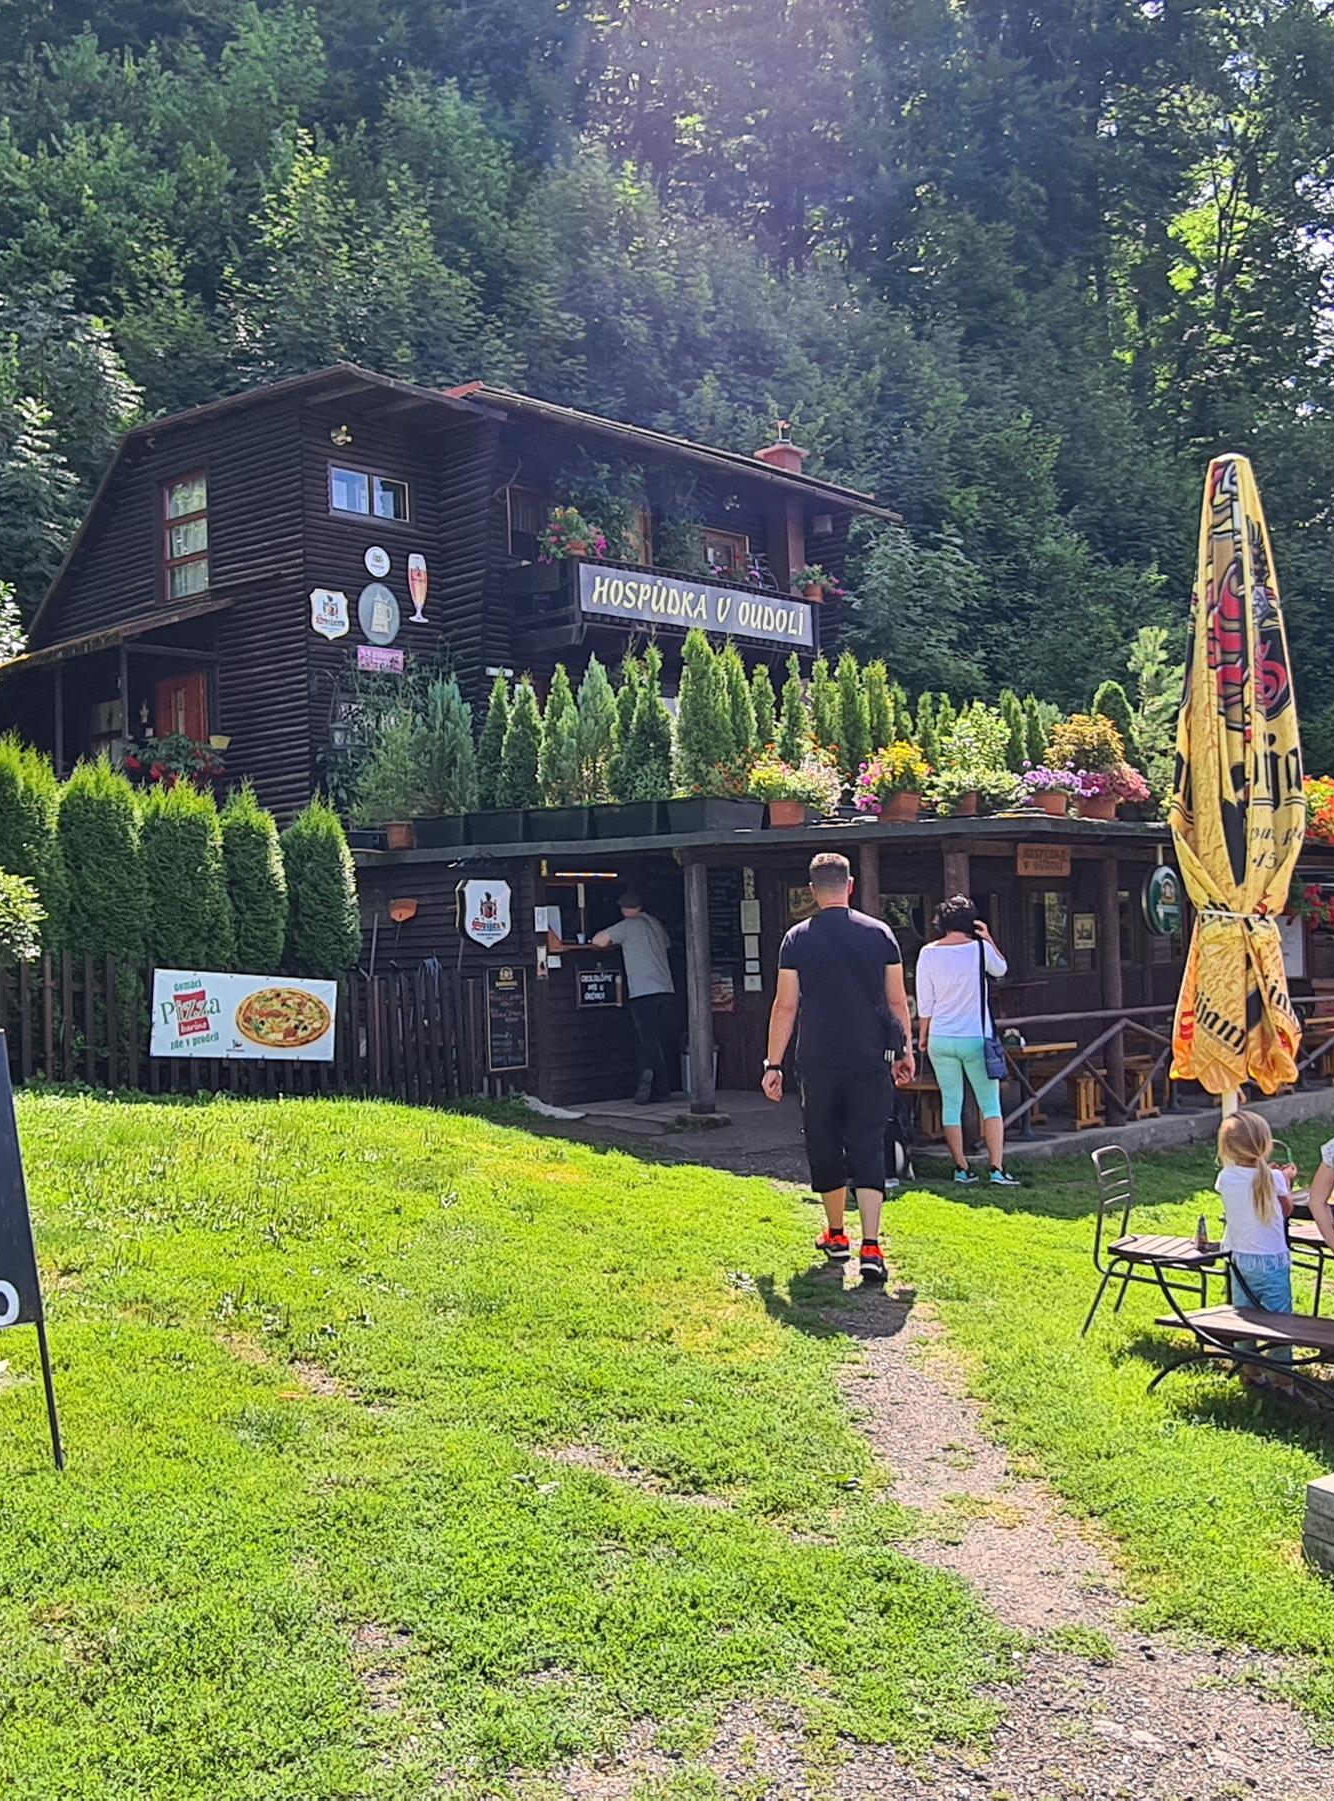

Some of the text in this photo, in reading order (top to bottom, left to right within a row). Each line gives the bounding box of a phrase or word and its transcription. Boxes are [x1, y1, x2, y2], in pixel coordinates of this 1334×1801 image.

[592, 576, 804, 635] HOSPŮDKA V OUDOLÍ
